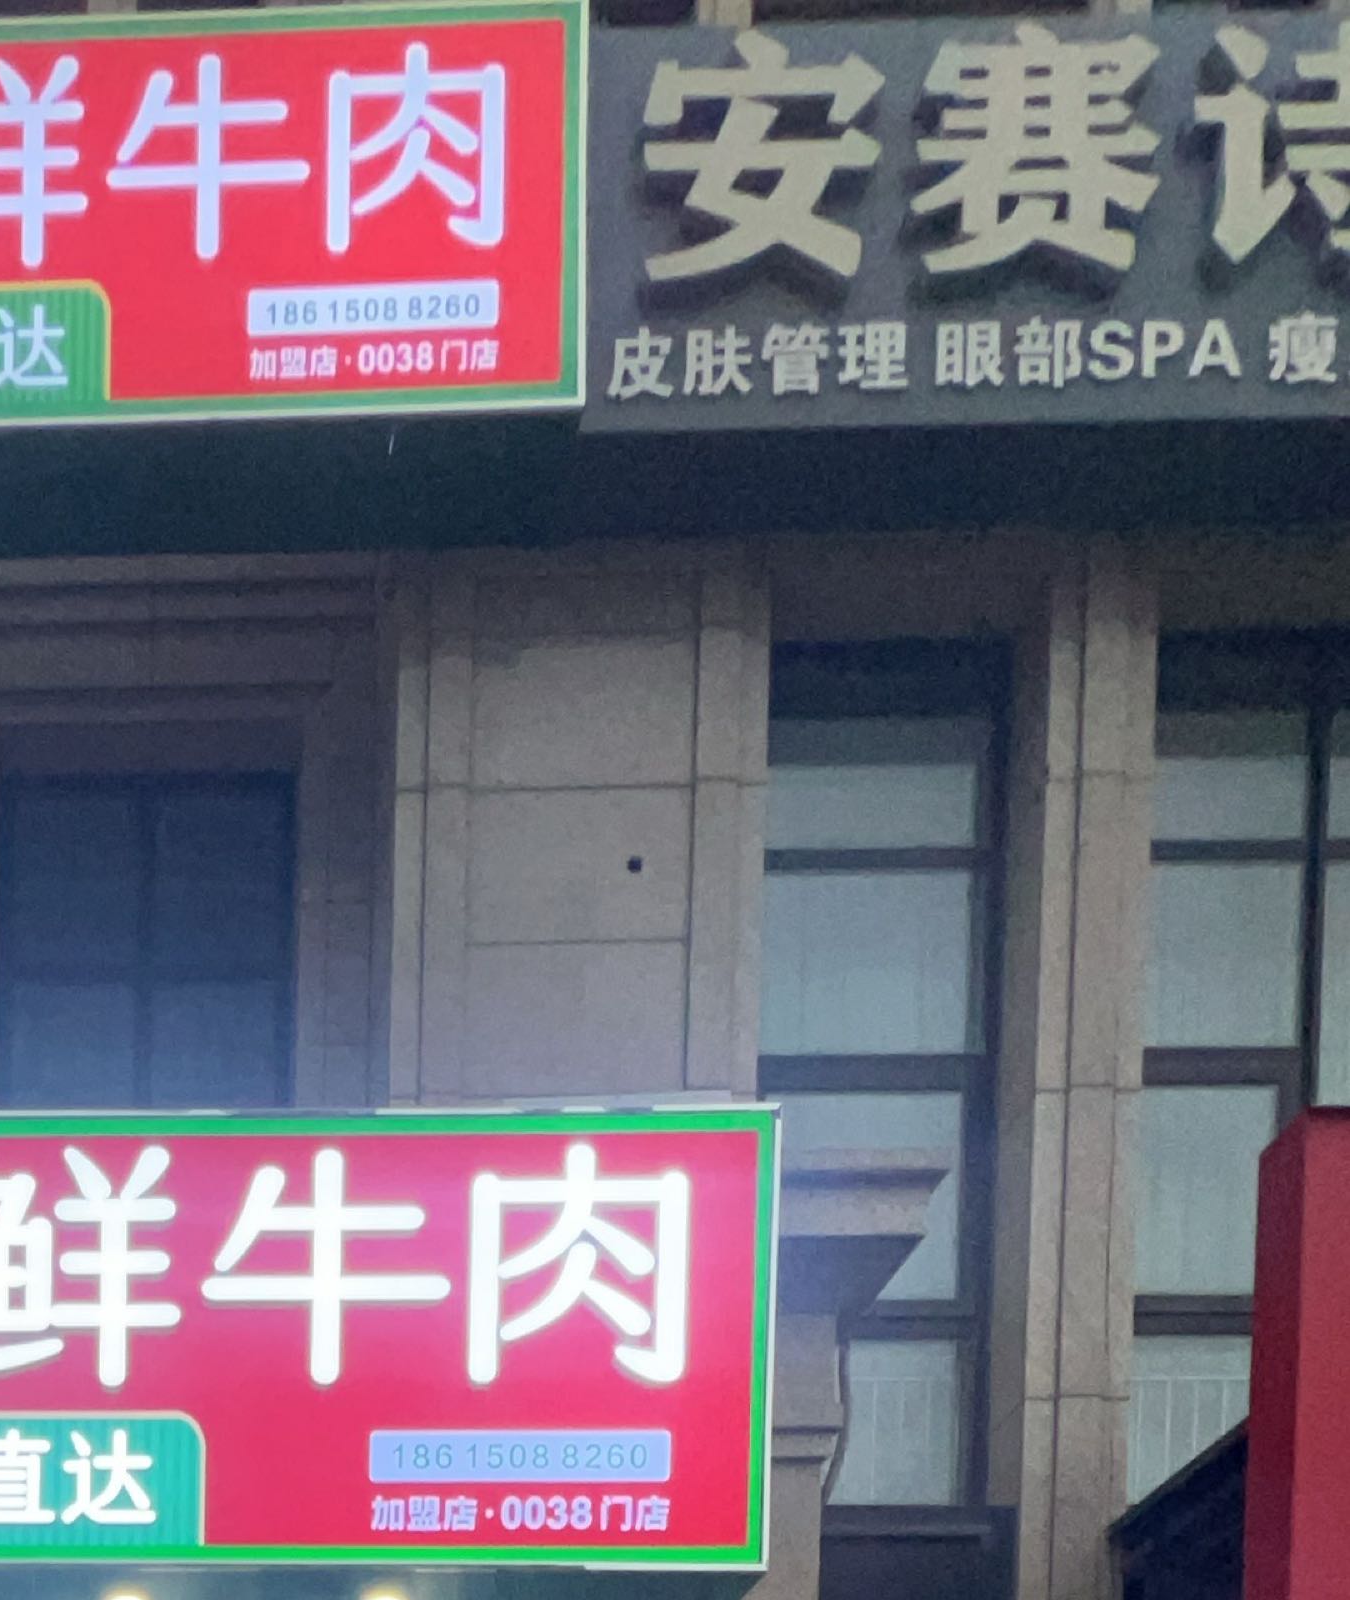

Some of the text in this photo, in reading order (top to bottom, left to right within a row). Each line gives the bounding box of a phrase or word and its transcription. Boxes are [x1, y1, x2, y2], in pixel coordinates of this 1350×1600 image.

[266, 293, 480, 326] 186 1508 8260
[607, 320, 909, 400] 皮肤管理
[934, 317, 1242, 389] 眼部SPA
[393, 1444, 648, 1469] 186 1508 8260
